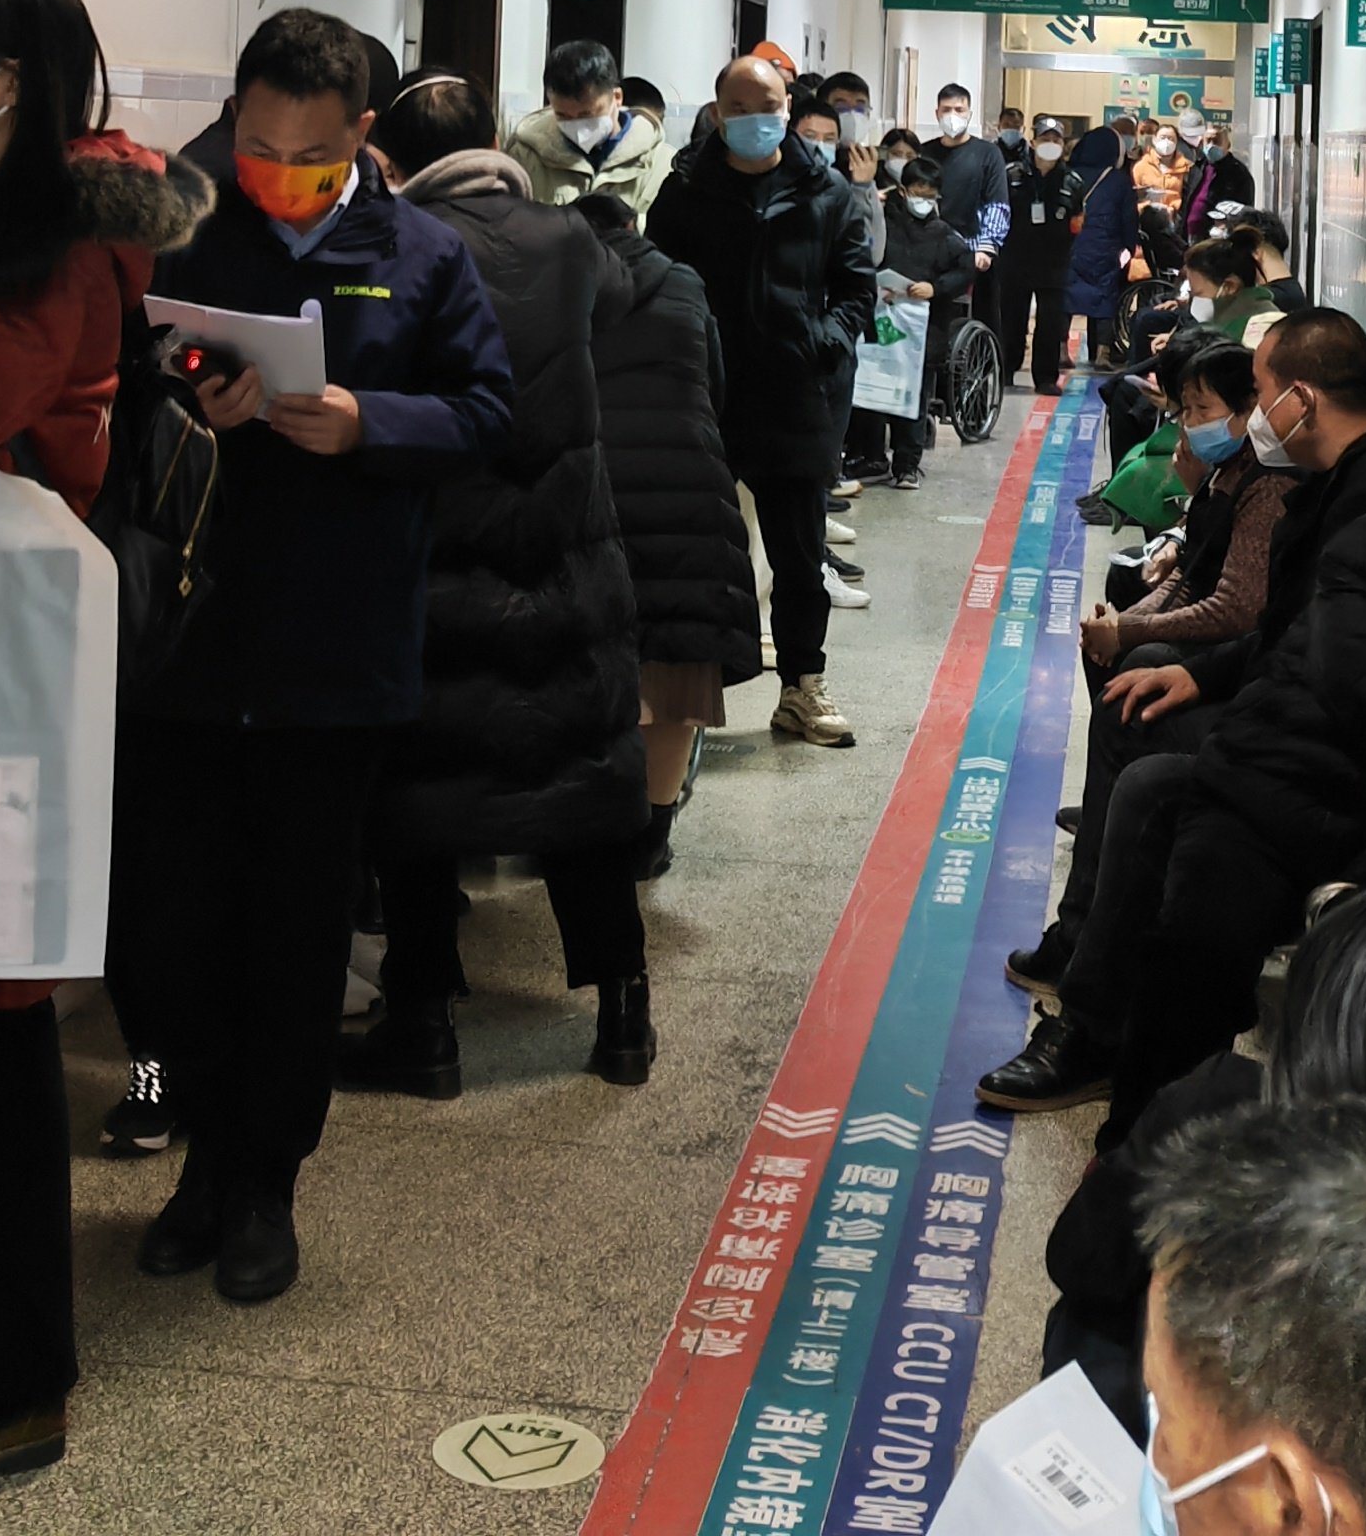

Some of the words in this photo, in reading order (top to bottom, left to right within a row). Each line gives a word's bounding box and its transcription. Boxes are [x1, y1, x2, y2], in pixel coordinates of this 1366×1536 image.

[679, 1155, 811, 1359] 急诊胸痛抢救室
[905, 1172, 991, 1314] 胸痛导管室
[891, 1321, 955, 1386] CCU
[497, 1422, 564, 1439] EXIT
[722, 1405, 829, 1536] 消化内镜
[848, 1392, 942, 1534] CT/DR室
